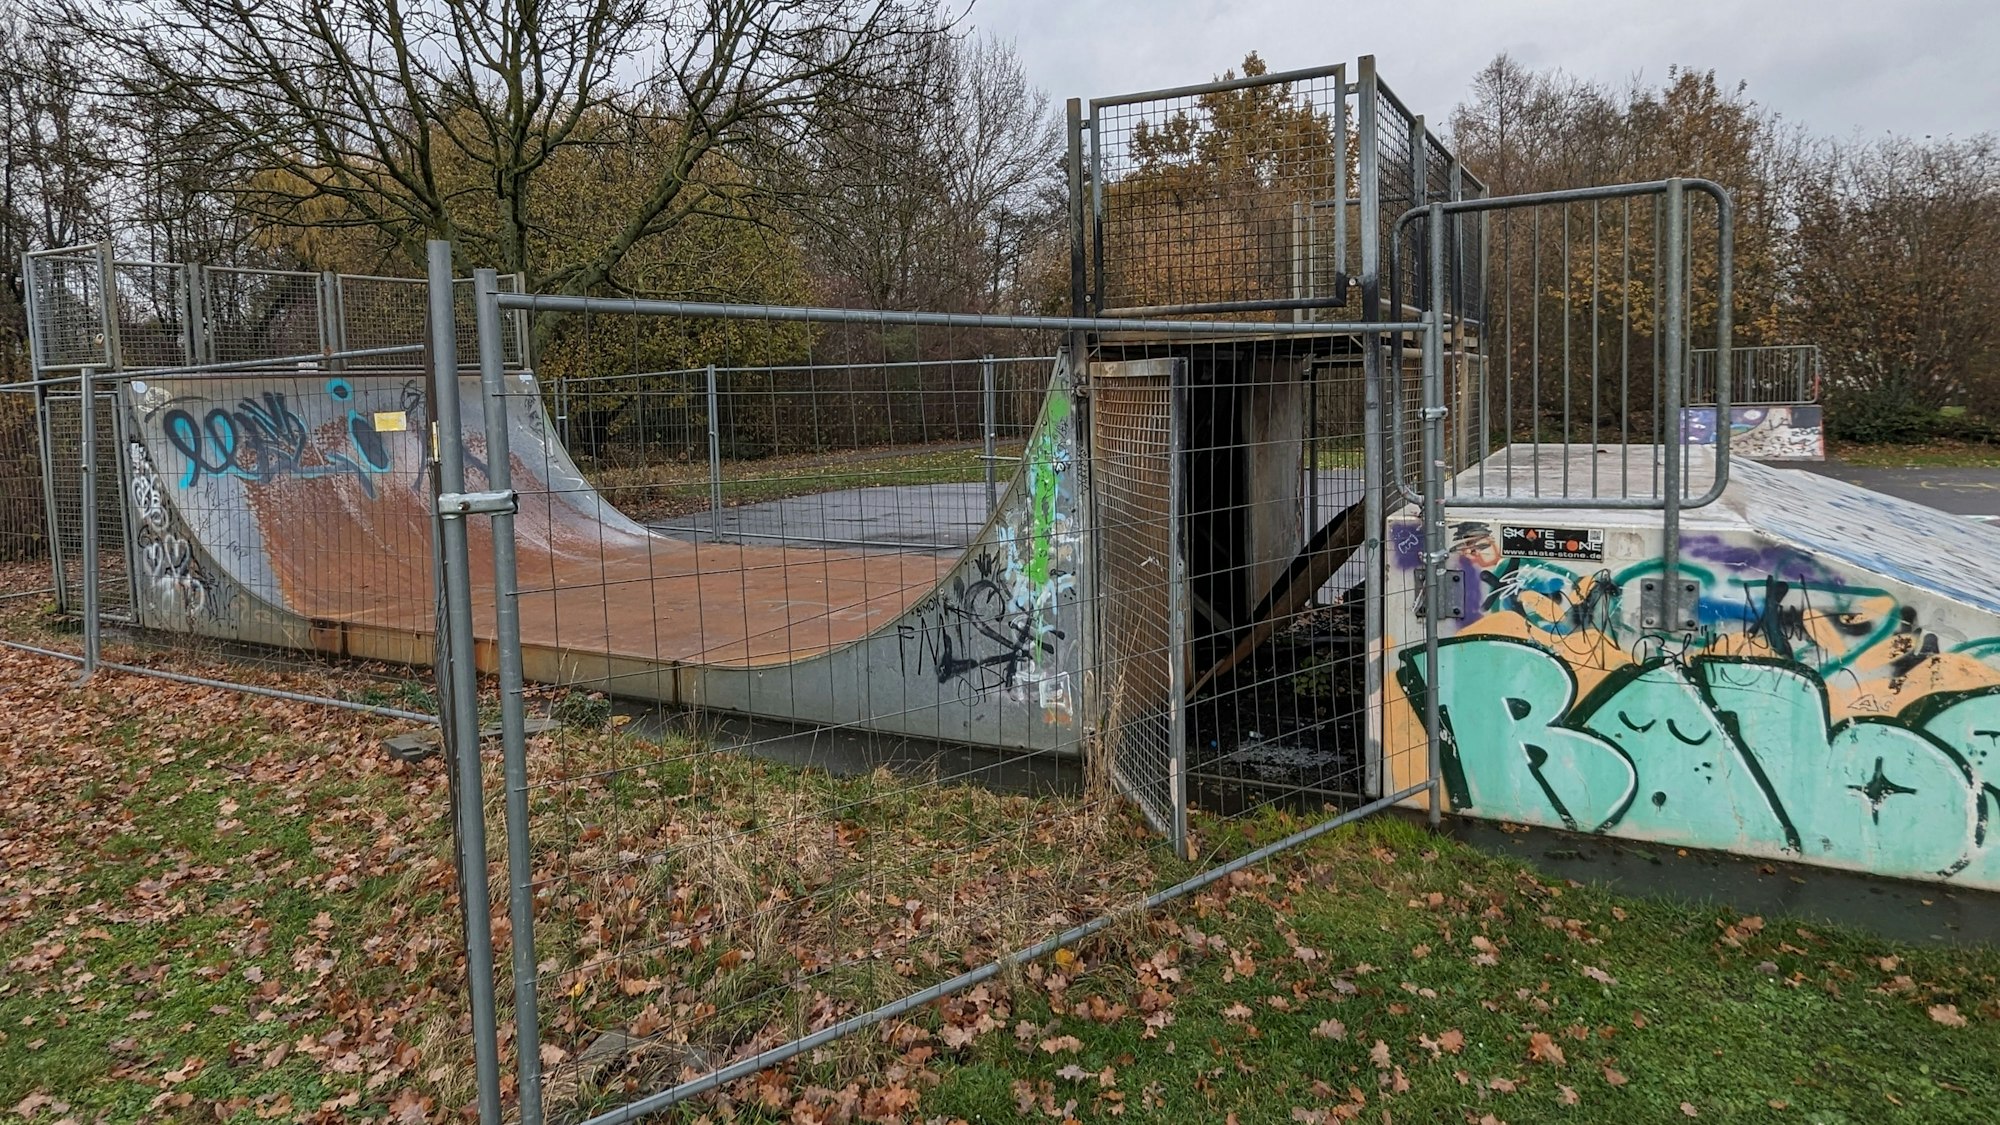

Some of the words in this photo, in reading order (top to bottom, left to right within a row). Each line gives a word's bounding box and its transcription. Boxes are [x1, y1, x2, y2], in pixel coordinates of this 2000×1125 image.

[1503, 527, 1555, 540] SKATE
[1544, 540, 1602, 552] STONE
[1503, 549, 1602, 559] www.skate-stone.de
